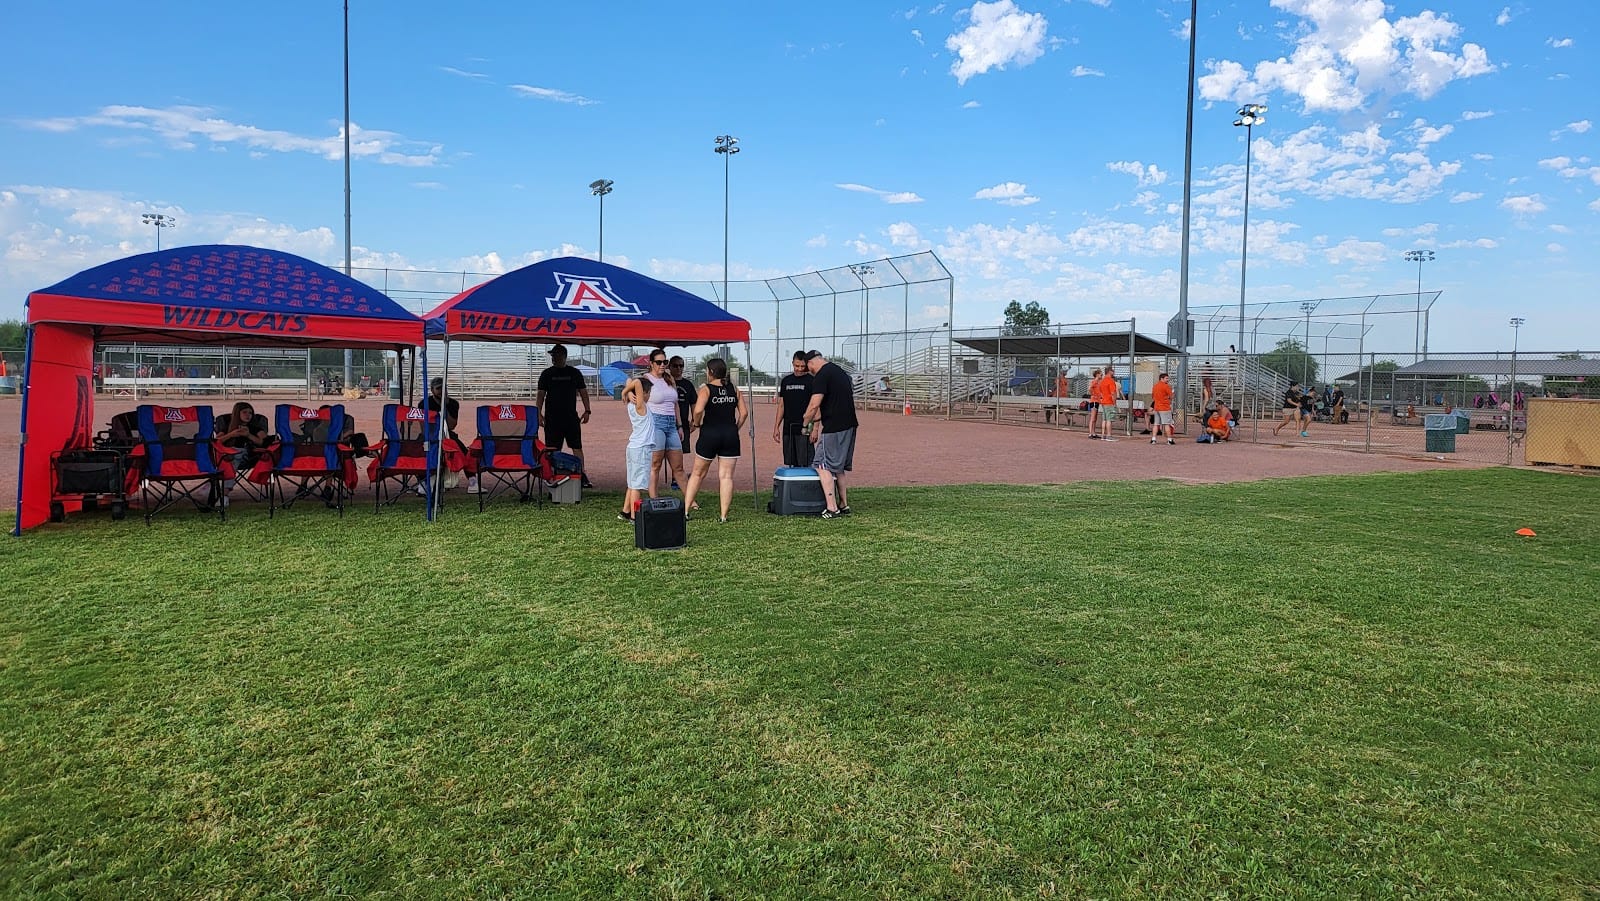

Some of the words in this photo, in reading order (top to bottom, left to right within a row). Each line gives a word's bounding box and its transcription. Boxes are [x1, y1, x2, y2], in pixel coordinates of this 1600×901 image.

[545, 272, 642, 316] A
[163, 306, 308, 332] WILDCATS
[460, 312, 577, 334] WILDCATS
[165, 408, 185, 421] A
[406, 407, 424, 419] A
[499, 405, 516, 419] A
